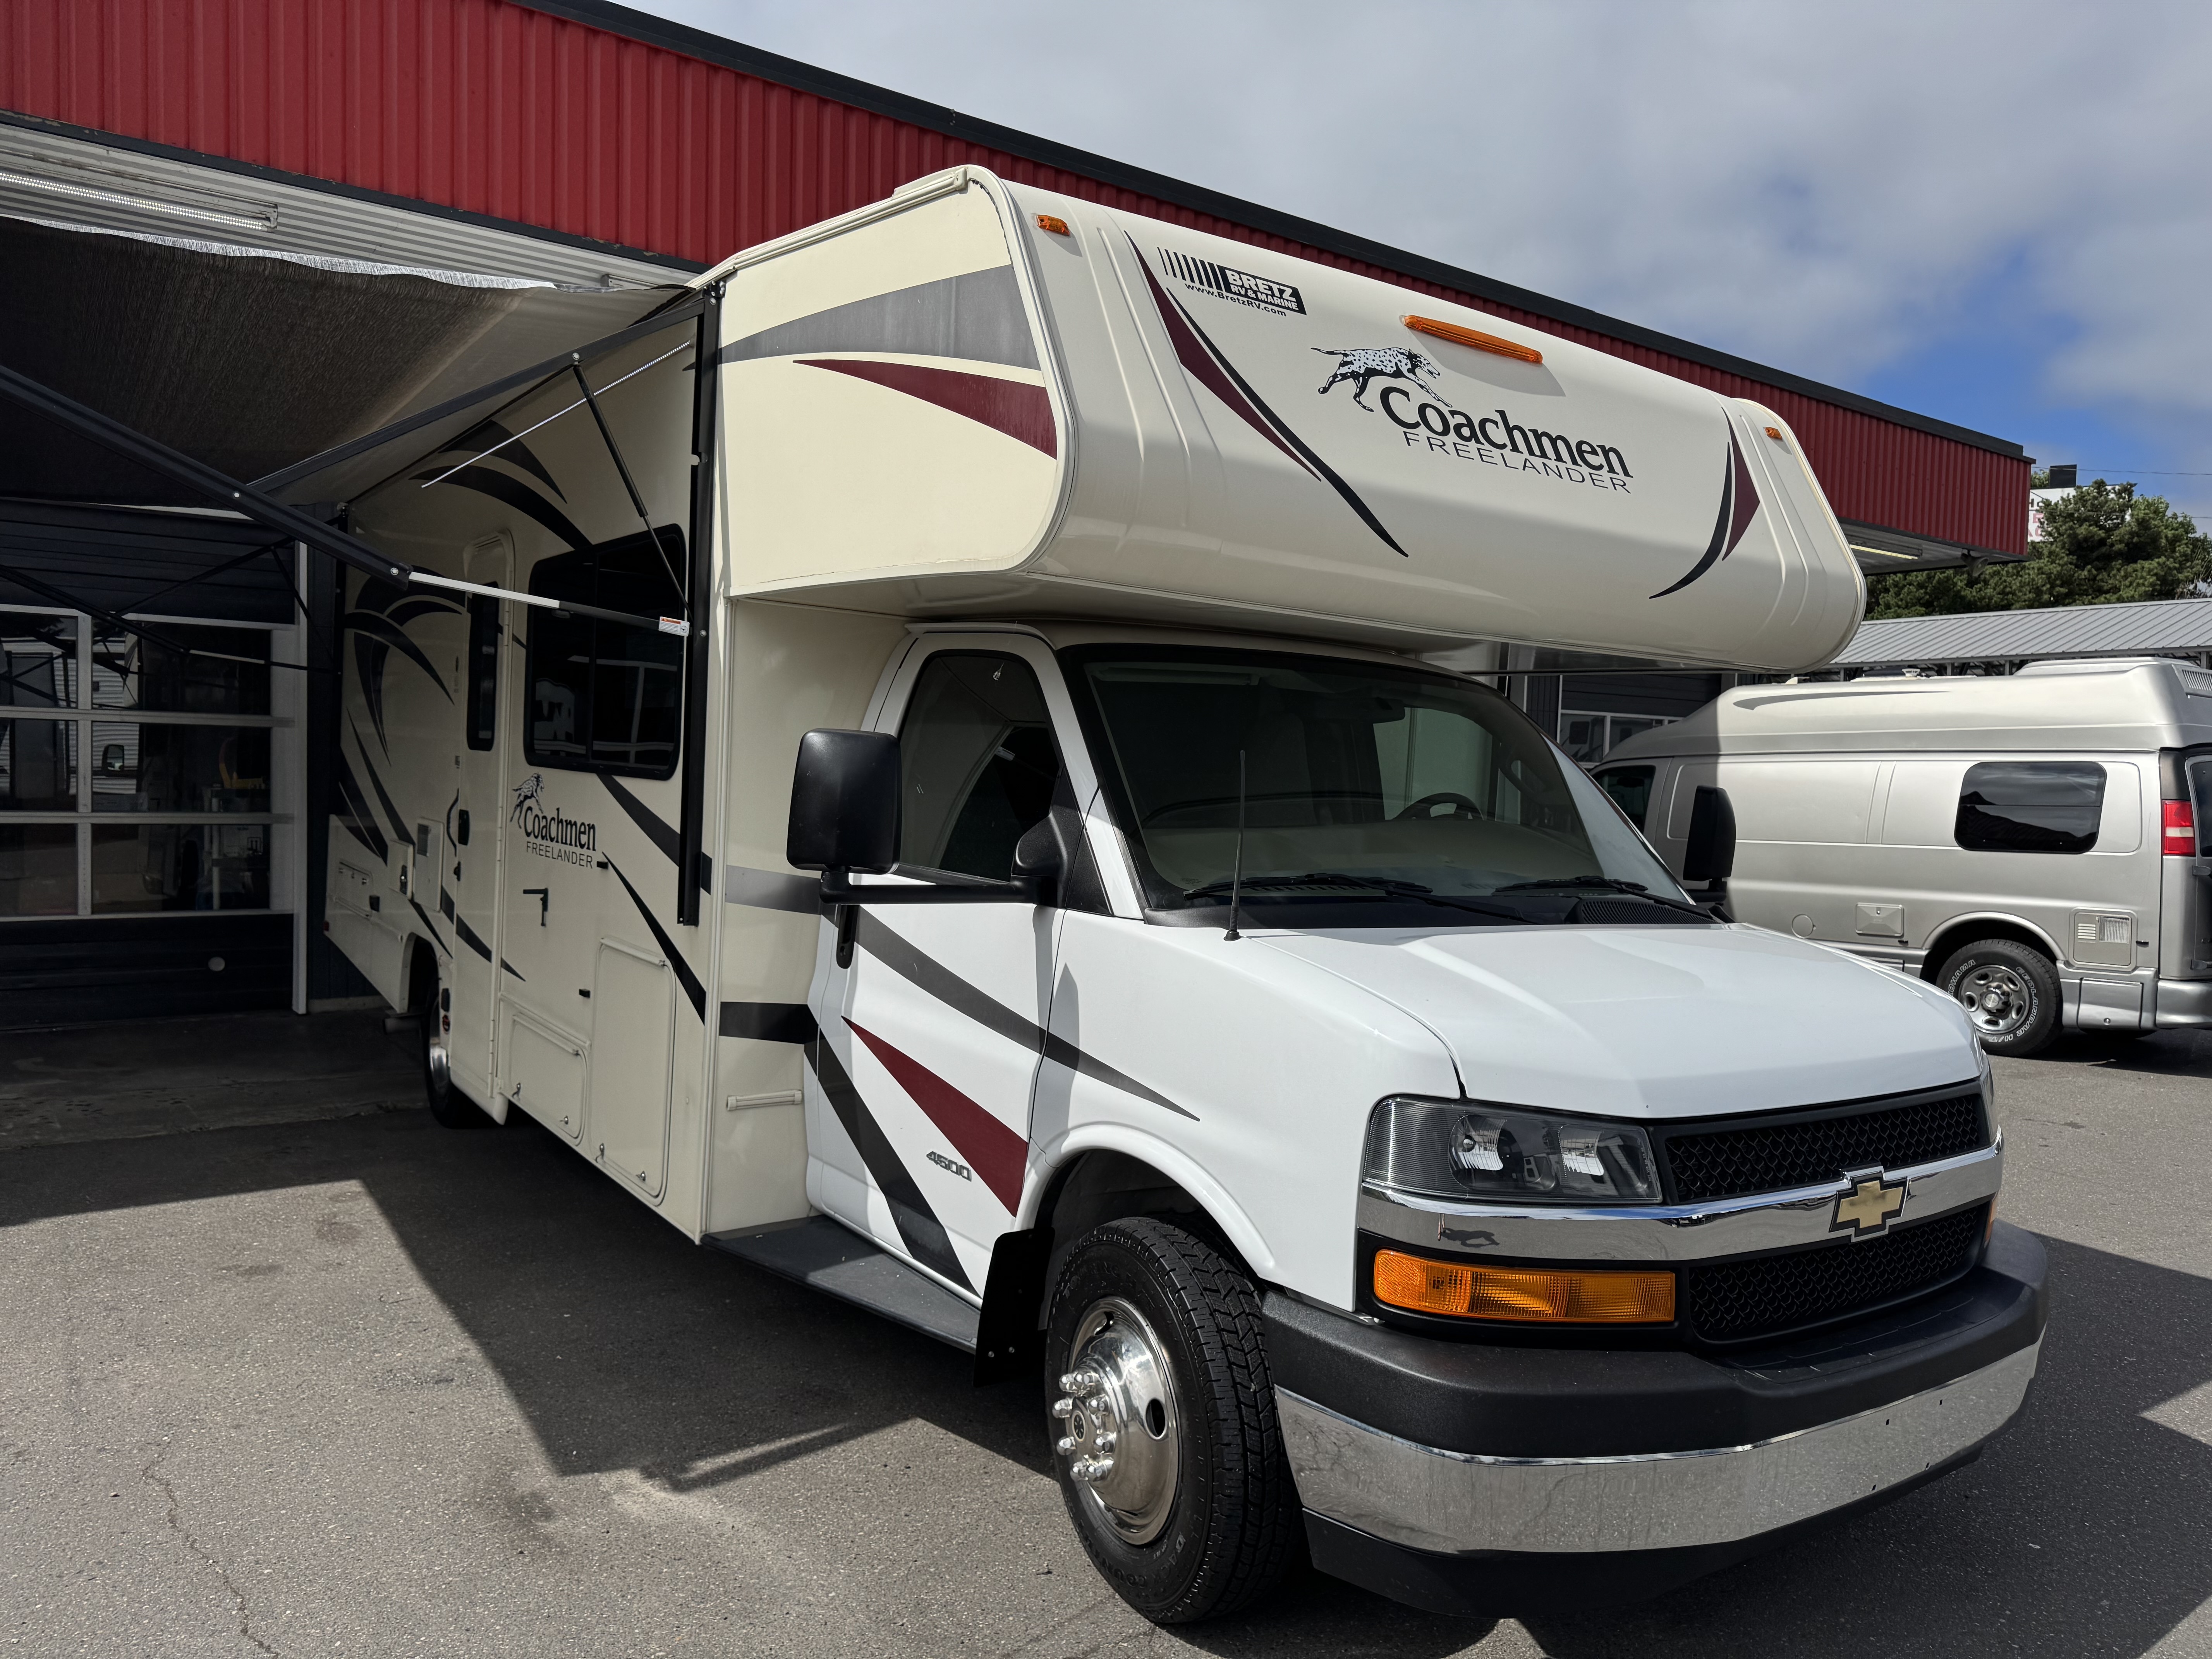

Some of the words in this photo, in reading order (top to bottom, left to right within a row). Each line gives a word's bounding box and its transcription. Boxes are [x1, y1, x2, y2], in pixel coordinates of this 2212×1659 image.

[1184, 283, 1287, 317] www.BretzRV.com
[1224, 269, 1297, 302] BRETZ
[1230, 283, 1246, 295] RV
[1247, 289, 1257, 299] &
[1258, 292, 1299, 311] MARINE
[1379, 386, 1634, 479] Coachmen
[1403, 431, 1632, 494] FREELANDER
[524, 805, 596, 852] Coachmen
[526, 840, 593, 869] FREELANDER
[1948, 959, 1976, 996] KOHAMA
[926, 1151, 972, 1182] 4500
